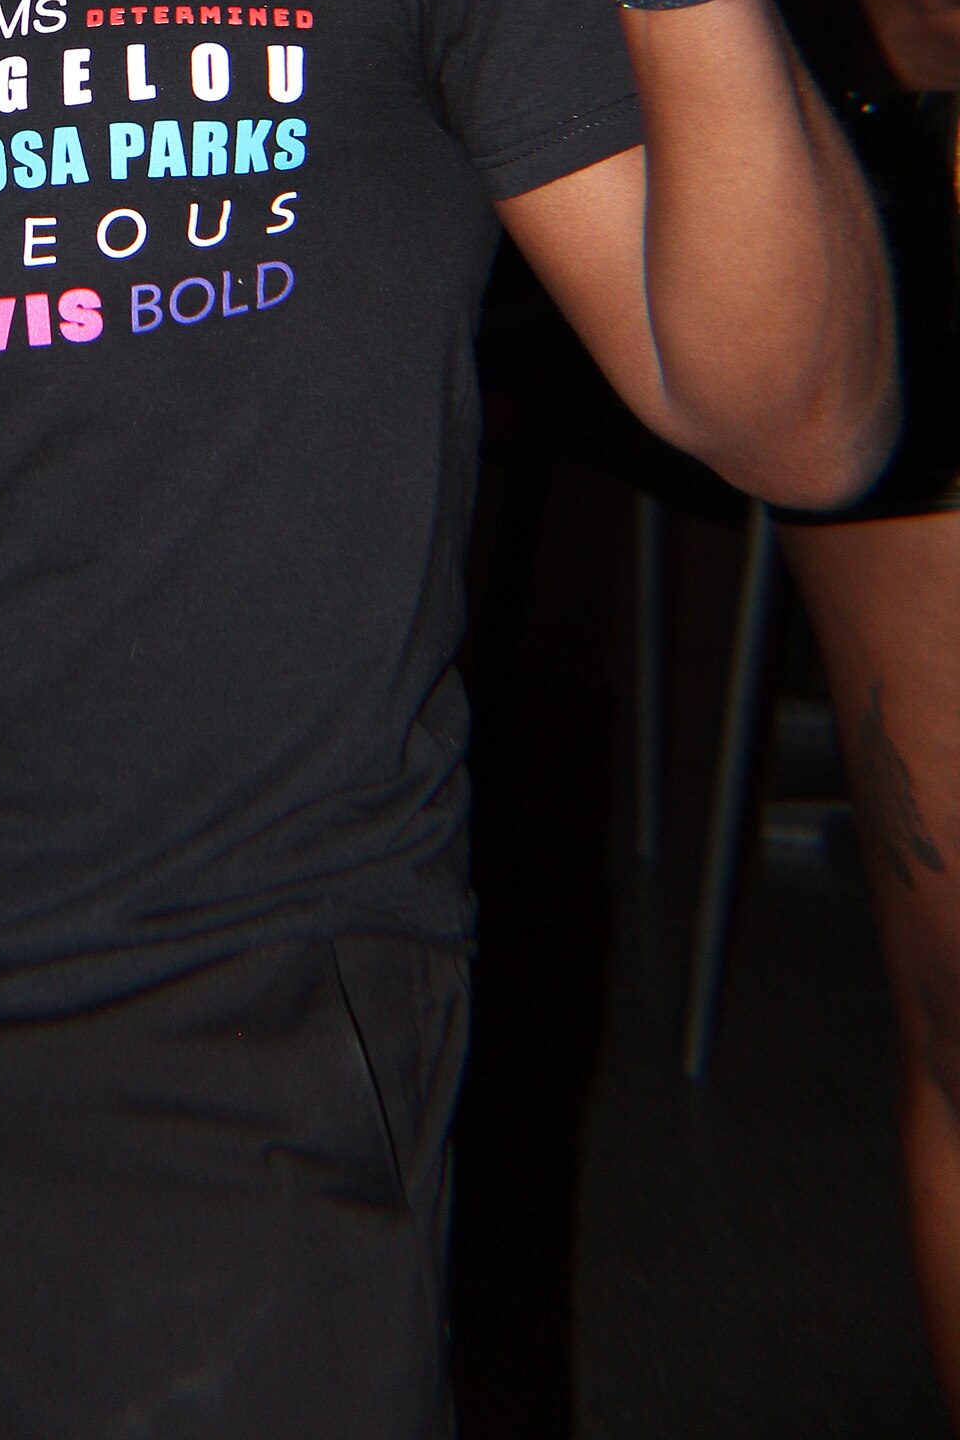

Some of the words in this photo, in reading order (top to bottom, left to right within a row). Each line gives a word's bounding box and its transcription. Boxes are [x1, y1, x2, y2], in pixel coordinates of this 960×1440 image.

[86, 5, 314, 29] DETERMINED
[108, 118, 308, 180] PARKS
[130, 261, 296, 335] BOLD
